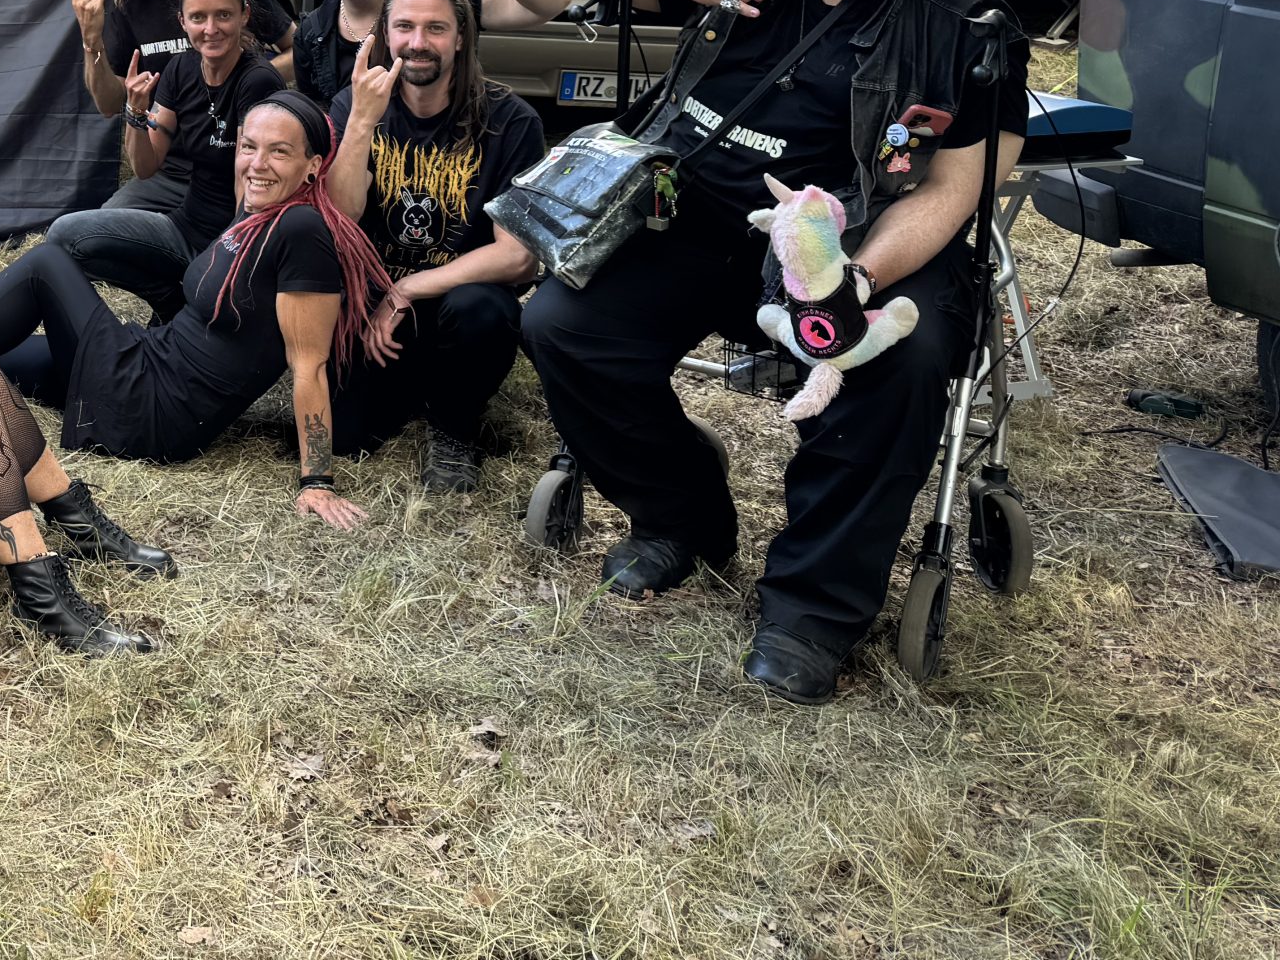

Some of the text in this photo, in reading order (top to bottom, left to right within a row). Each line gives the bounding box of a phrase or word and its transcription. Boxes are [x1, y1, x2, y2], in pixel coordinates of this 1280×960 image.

[576, 76, 605, 97] RZ
[682, 96, 788, 158] ORTHER RAVENS
